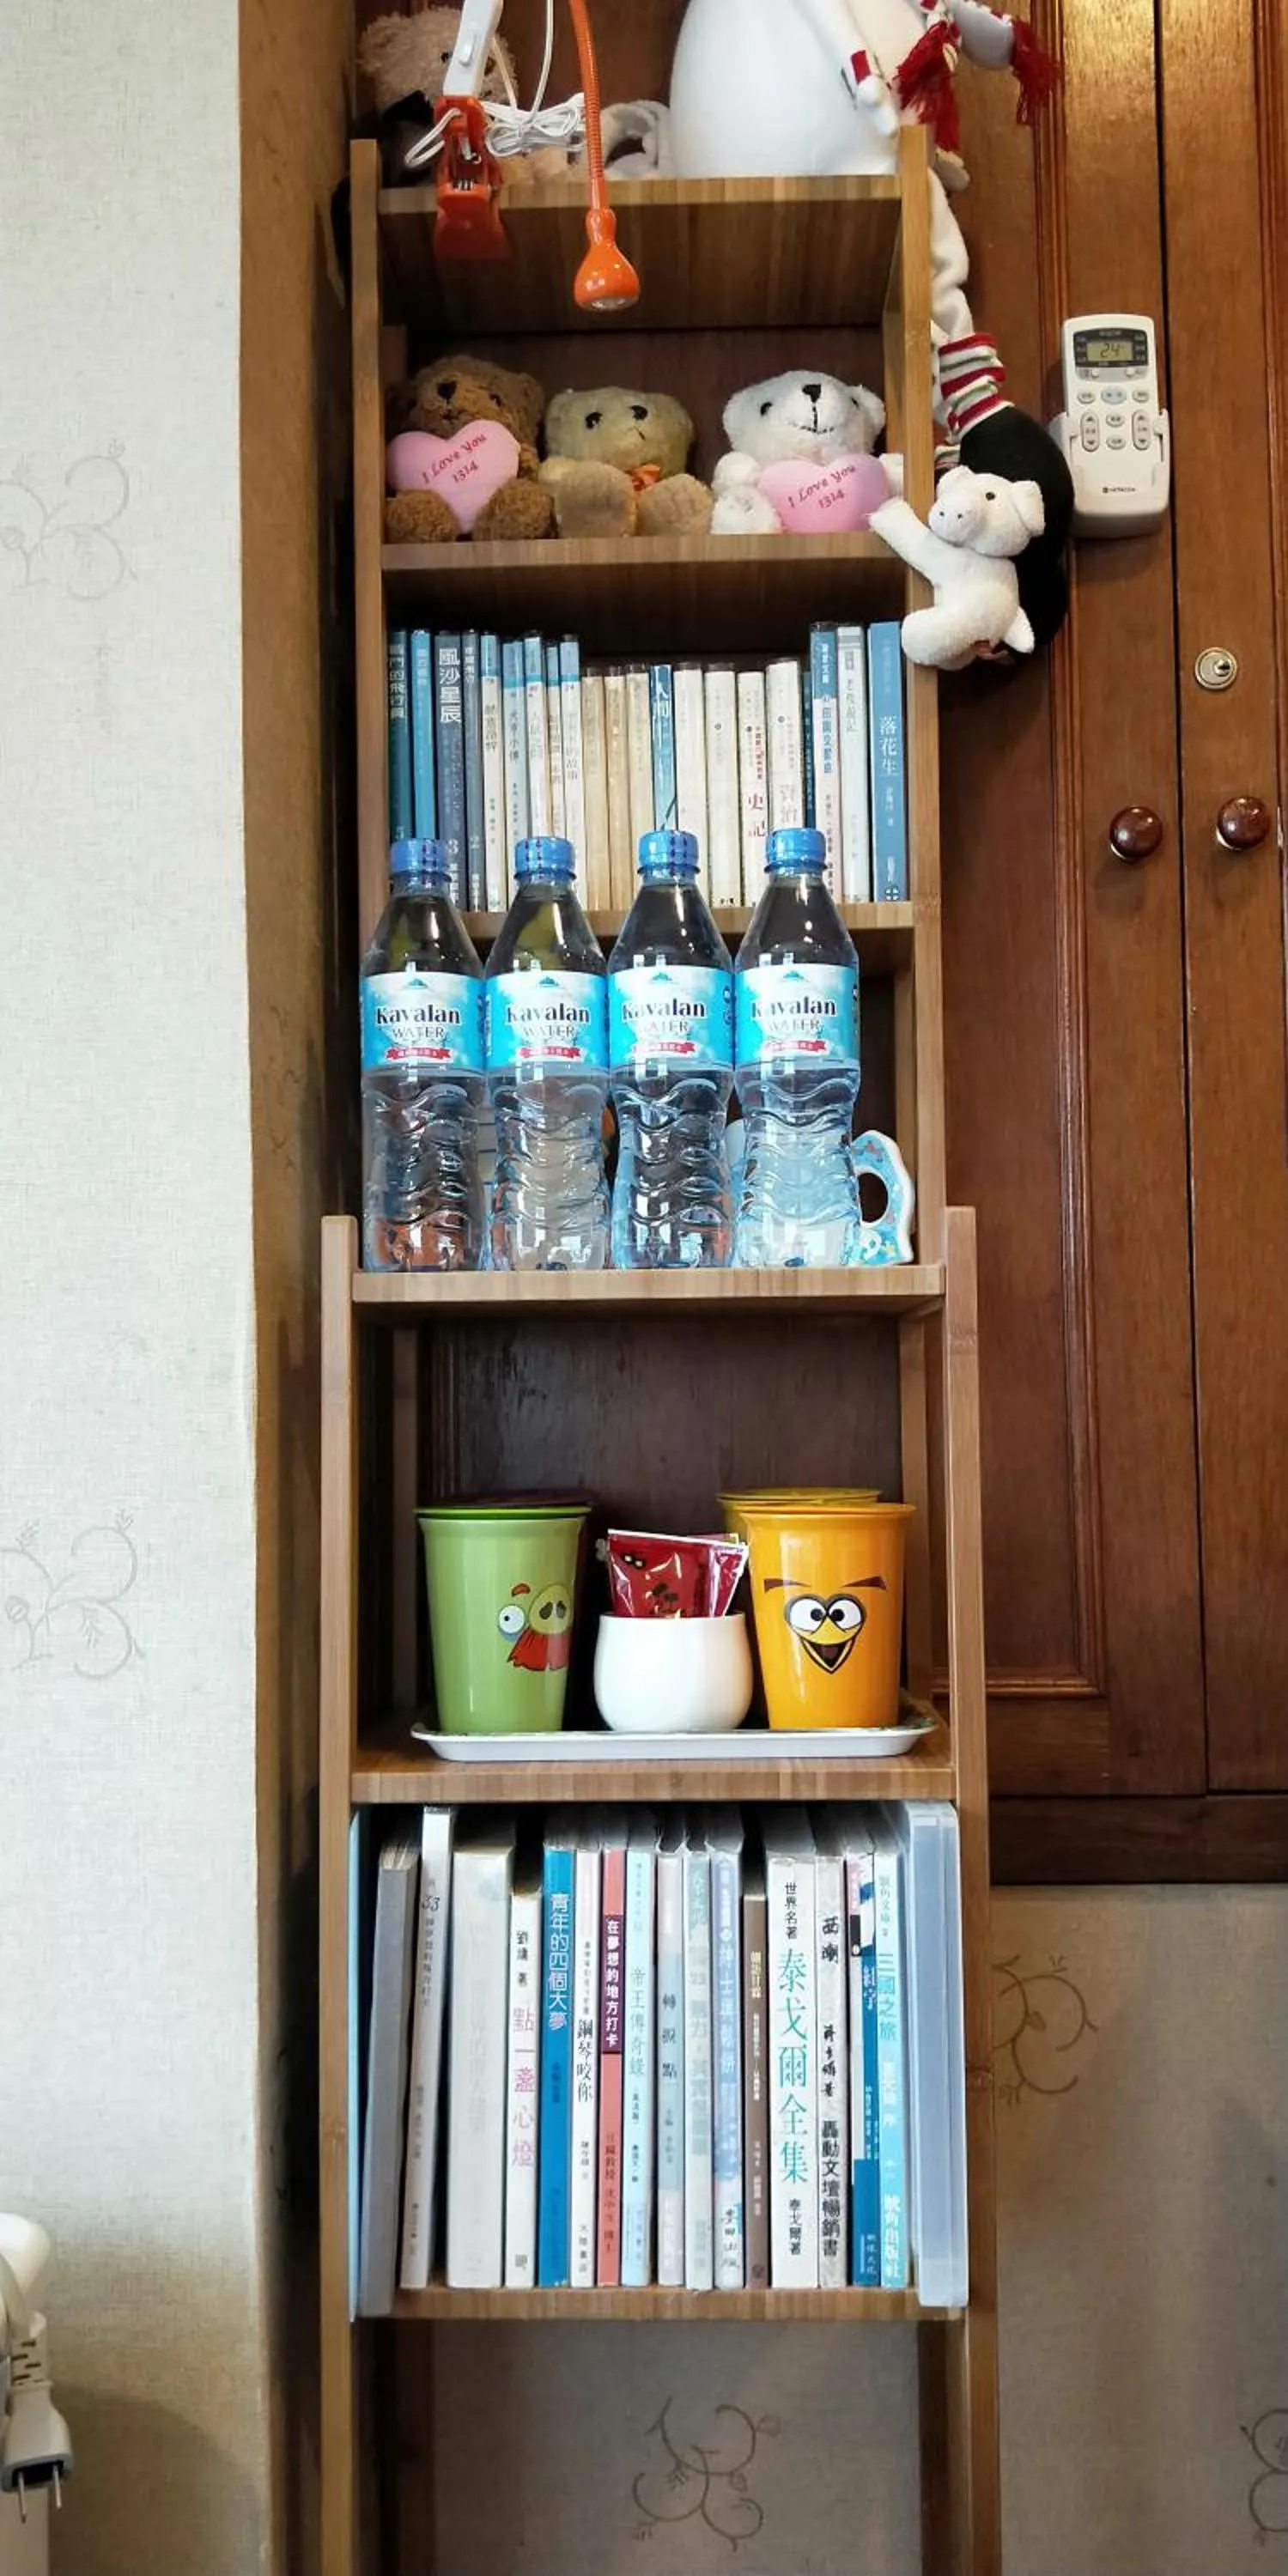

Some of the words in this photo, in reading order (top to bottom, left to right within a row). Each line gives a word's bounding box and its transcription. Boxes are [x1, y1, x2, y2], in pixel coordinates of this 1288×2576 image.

[1100, 343, 1121, 358] 24
[432, 451, 460, 477] Love
[460, 434, 487, 453] You
[452, 460, 478, 483] 1314
[799, 478, 829, 502] Love
[830, 465, 856, 483] You
[818, 489, 845, 508] 1314
[439, 647, 461, 723] 風沙星辰
[879, 715, 898, 777] 落花生
[748, 792, 766, 837] 史記
[376, 1004, 460, 1024] Kavalan
[392, 1026, 445, 1038] WATER
[507, 1002, 590, 1024] Kavalan
[640, 1020, 689, 1032] ATER
[785, 1881, 798, 1941] 世界名著
[548, 1893, 569, 2032] 青年的四個大夢
[605, 1919, 620, 2048] 在夢想的地方打卡
[575, 2019, 594, 2104] 鋼琴咬你
[778, 1947, 809, 2184] 泰戈爾全集
[513, 2007, 536, 2169] 點一盞心燈
[821, 2120, 841, 2257] 轟動文壇暢銷書
[788, 2198, 802, 2257] 泰戈爾著
